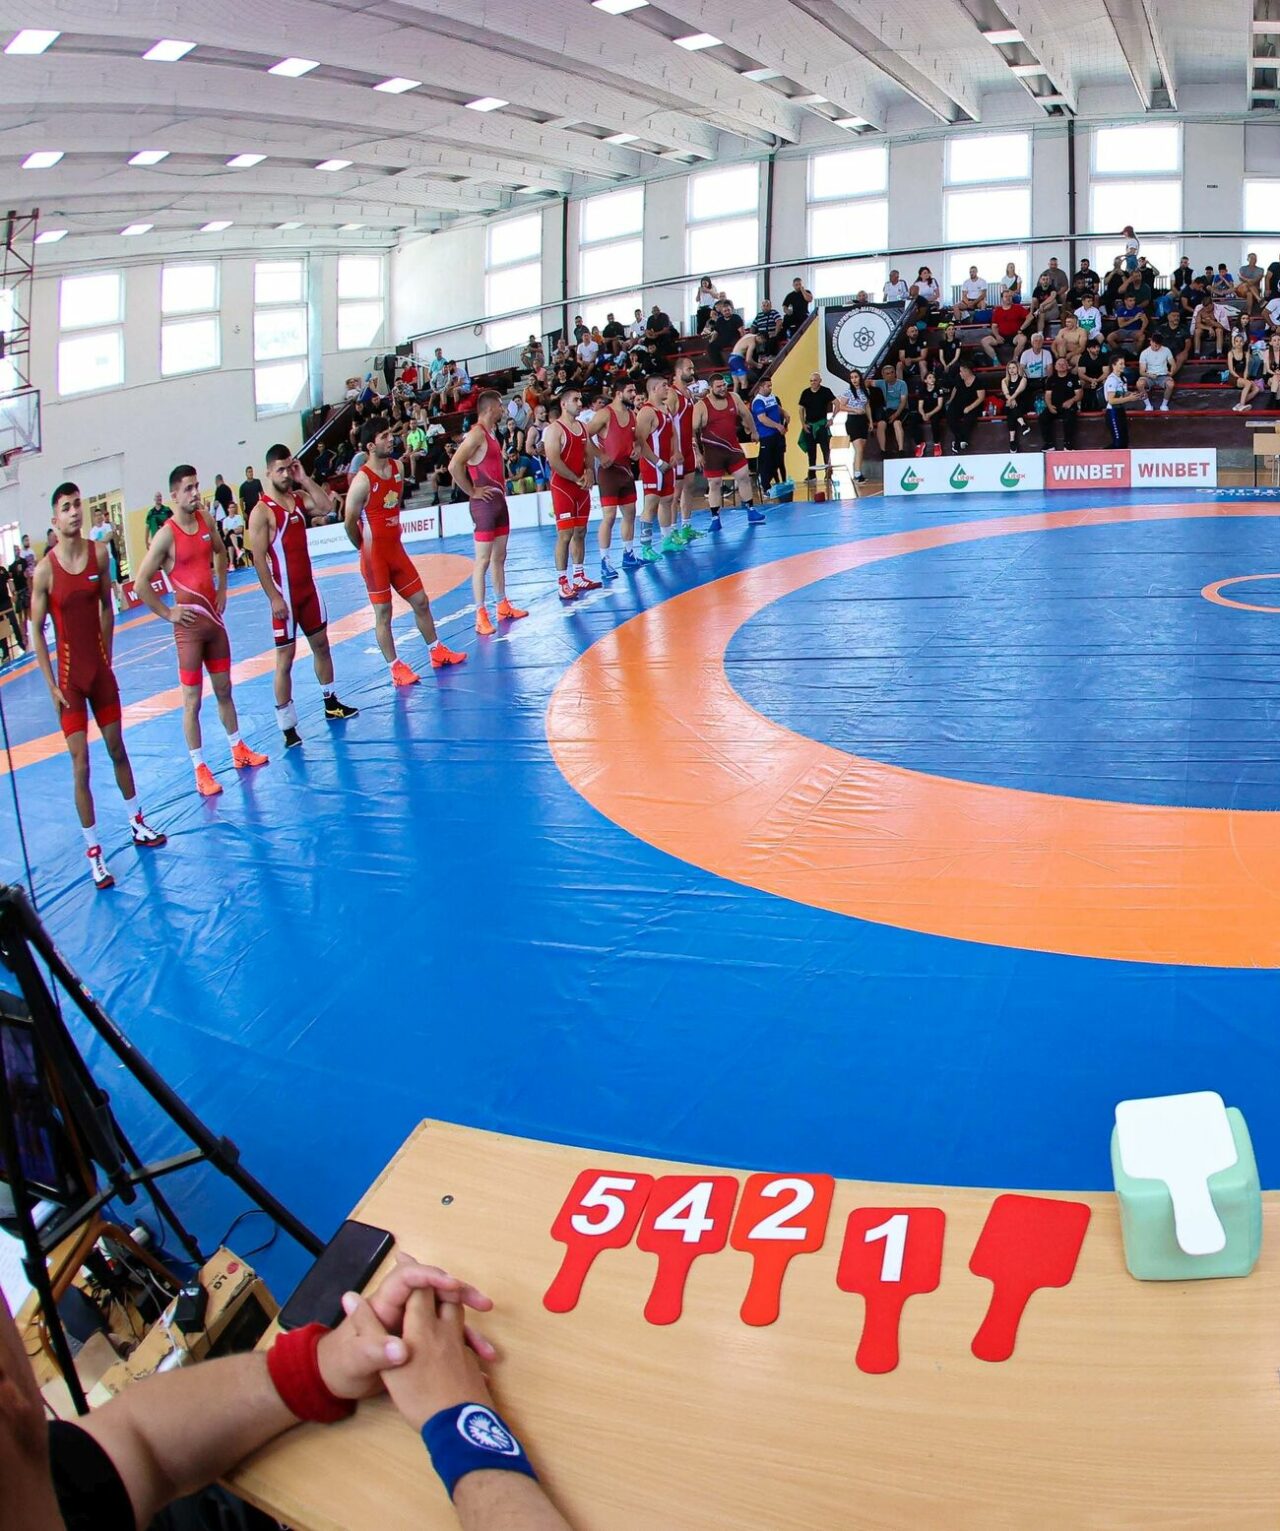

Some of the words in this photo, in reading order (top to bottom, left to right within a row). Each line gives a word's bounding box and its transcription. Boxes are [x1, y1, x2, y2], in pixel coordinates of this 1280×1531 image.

[1053, 463, 1125, 481] WINBET
[1137, 462, 1210, 478] WINBET
[570, 1176, 637, 1236] 5
[654, 1182, 714, 1243] 4
[747, 1177, 815, 1240] 2
[864, 1214, 909, 1283] 1
